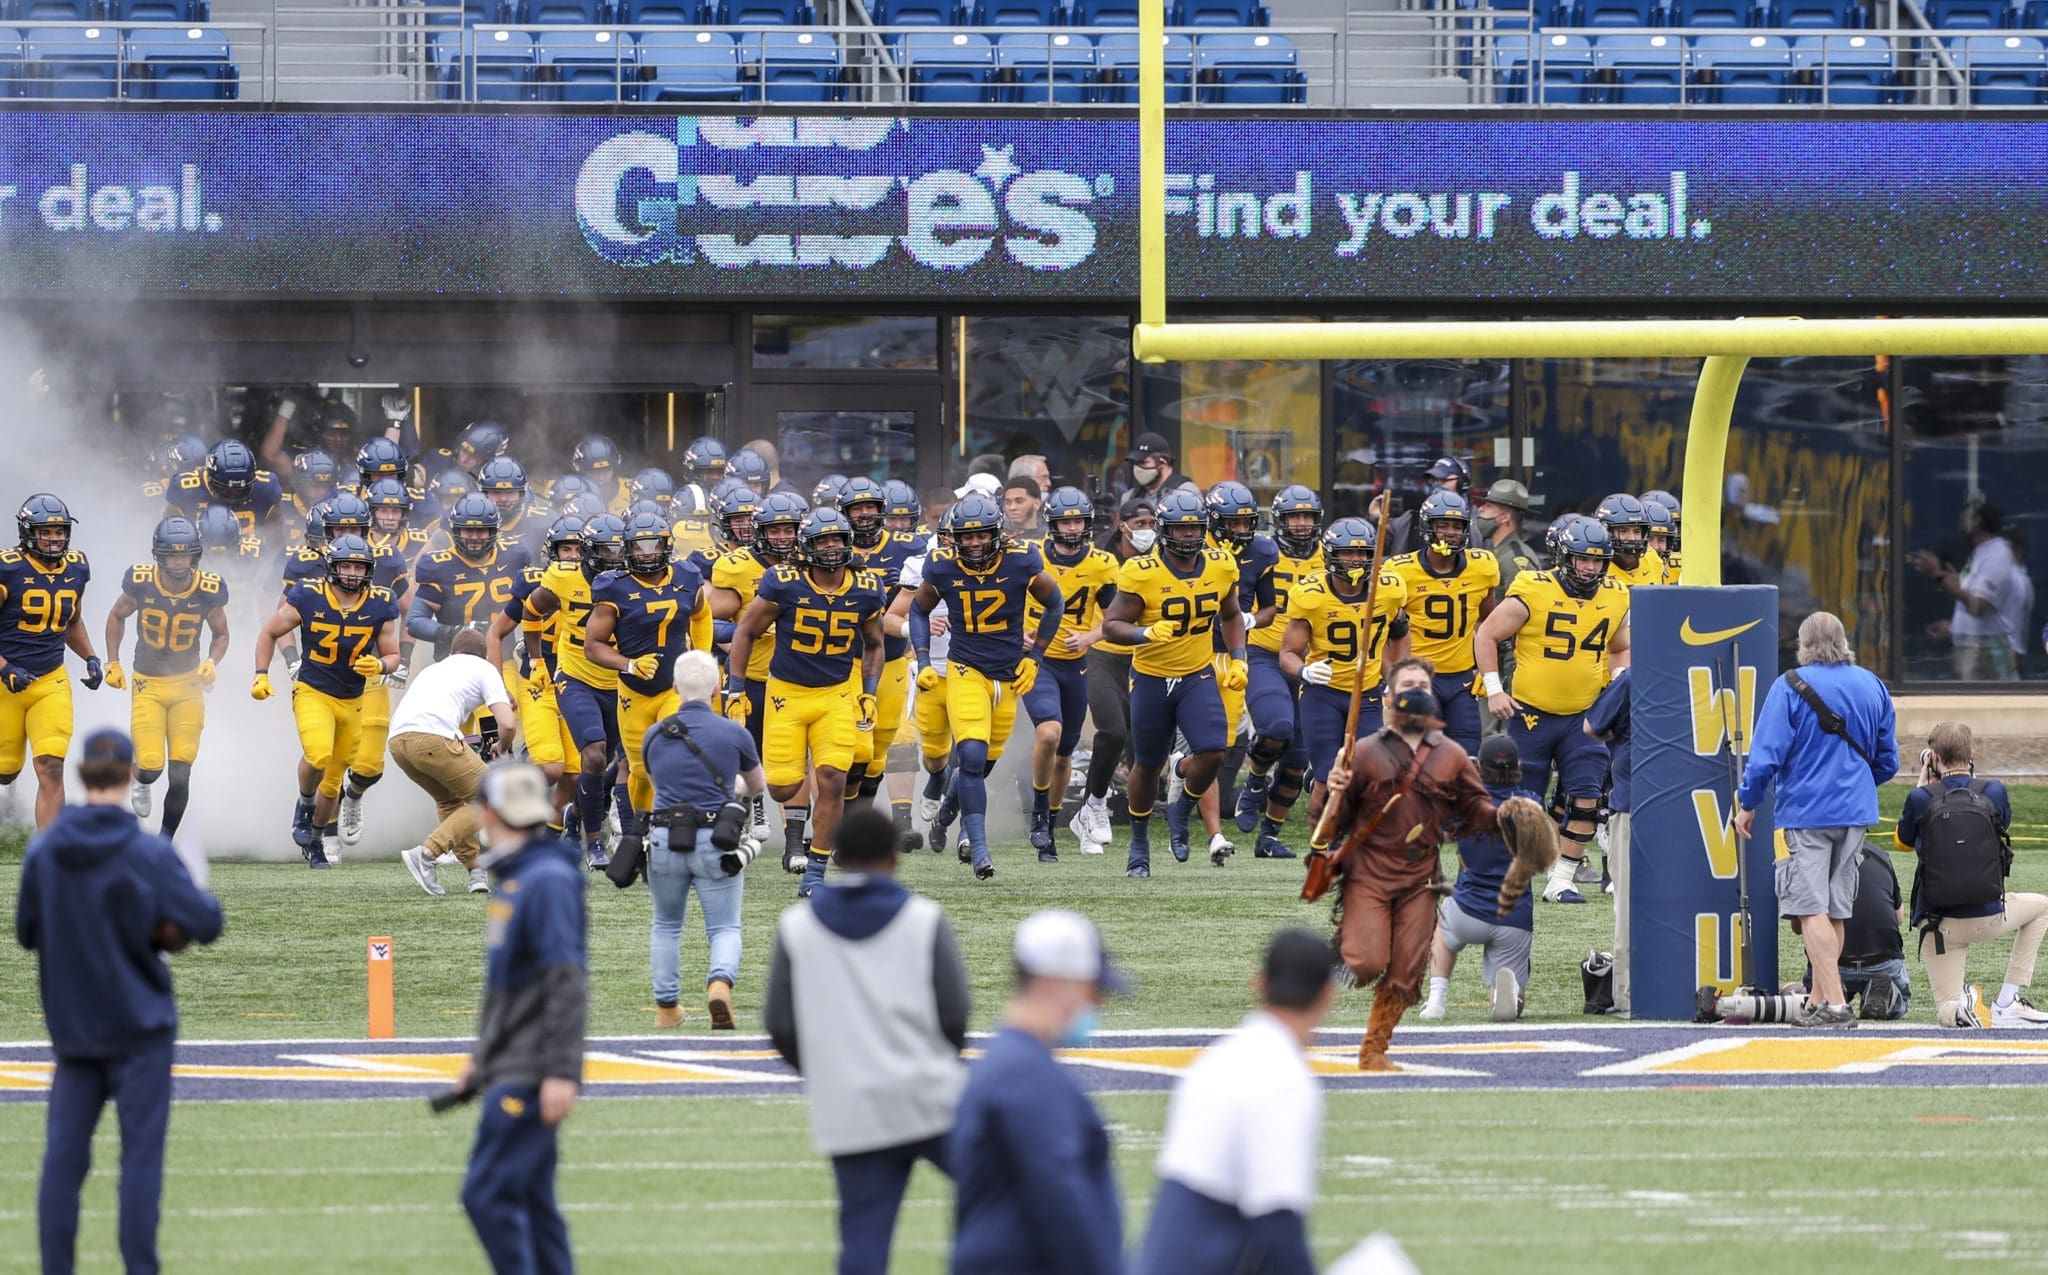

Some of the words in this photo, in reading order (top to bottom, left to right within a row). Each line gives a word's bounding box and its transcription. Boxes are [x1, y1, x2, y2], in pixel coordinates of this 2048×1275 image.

[38, 163, 224, 233] deal.
[1335, 191, 1512, 257] your
[1530, 170, 1713, 239] deal.
[17, 588, 78, 634] 90
[141, 607, 202, 652] 86
[645, 598, 679, 648] 7
[790, 607, 860, 656] 55
[959, 589, 1008, 633] 12
[1161, 591, 1219, 638] 95
[1424, 594, 1468, 640] 91
[308, 621, 375, 666] 37
[1326, 614, 1388, 663] 97
[1543, 611, 1610, 663] 54
